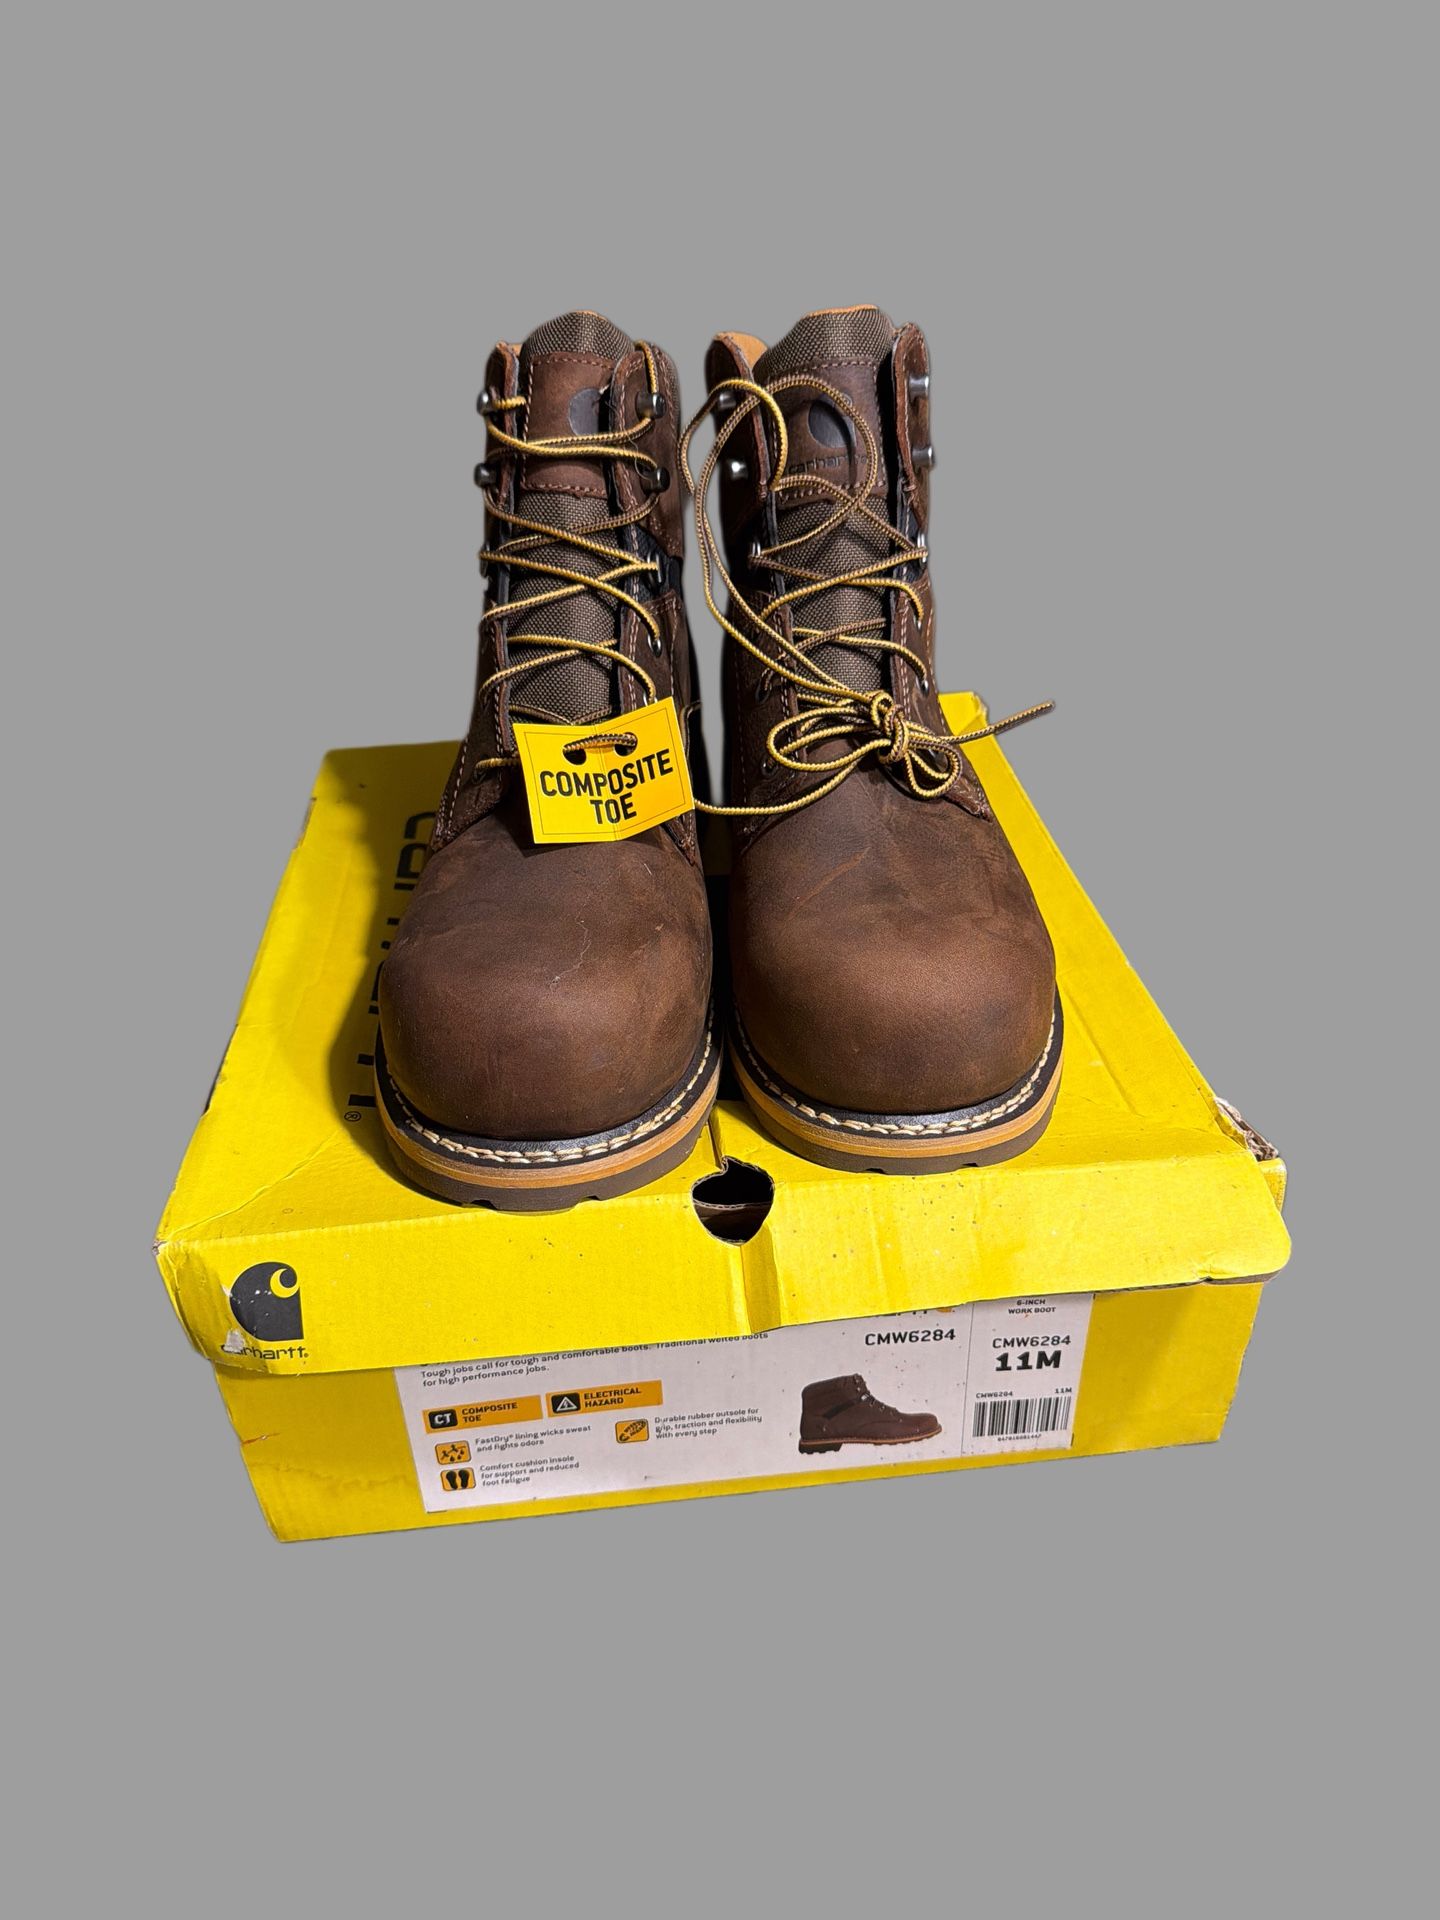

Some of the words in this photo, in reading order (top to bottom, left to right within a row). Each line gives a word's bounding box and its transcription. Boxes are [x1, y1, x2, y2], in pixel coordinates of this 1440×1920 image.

[539, 749, 674, 797] COMPOSITE
[590, 792, 637, 824] TOE
[864, 1329, 956, 1346] CMW6284
[992, 1335, 1071, 1348] CMW6284
[421, 1367, 450, 1378] Tough
[452, 1365, 474, 1376] jobs
[475, 1361, 493, 1370] call
[495, 1360, 510, 1368] for
[511, 1356, 539, 1366] tough
[541, 1353, 560, 1362] and
[561, 1347, 620, 1360] comfortable
[995, 1350, 1062, 1371] 11M
[423, 1379, 437, 1387] for
[438, 1376, 460, 1386] high
[462, 1369, 524, 1384] performance
[526, 1364, 550, 1375] jobs.
[583, 1387, 642, 1400] ELECTRICAL
[461, 1402, 518, 1415] COMPOSITE
[584, 1397, 624, 1408] HAZARD
[434, 1412, 452, 1425] CT
[462, 1414, 482, 1423] TOE
[654, 1414, 687, 1424] Durable
[687, 1411, 715, 1421] rubber
[716, 1408, 746, 1418] outsole
[747, 1407, 759, 1415] for
[674, 1421, 707, 1430] traction
[708, 1418, 724, 1426] and
[725, 1414, 763, 1425] flexibility
[515, 1431, 539, 1440] lining
[540, 1428, 565, 1436] wicks
[566, 1425, 592, 1433] sweat
[655, 1431, 674, 1440] with
[674, 1430, 698, 1439] every
[699, 1427, 718, 1436] step
[477, 1444, 492, 1452] and
[494, 1440, 519, 1451] fights
[520, 1439, 545, 1447] odors
[480, 1461, 514, 1472] Comfort
[515, 1458, 548, 1468] cushion
[549, 1455, 575, 1463] insole
[494, 1469, 527, 1479] support
[529, 1466, 545, 1474] and
[545, 1462, 580, 1472] reduced
[482, 1479, 500, 1487] foot
[501, 1475, 531, 1485] fatigue
